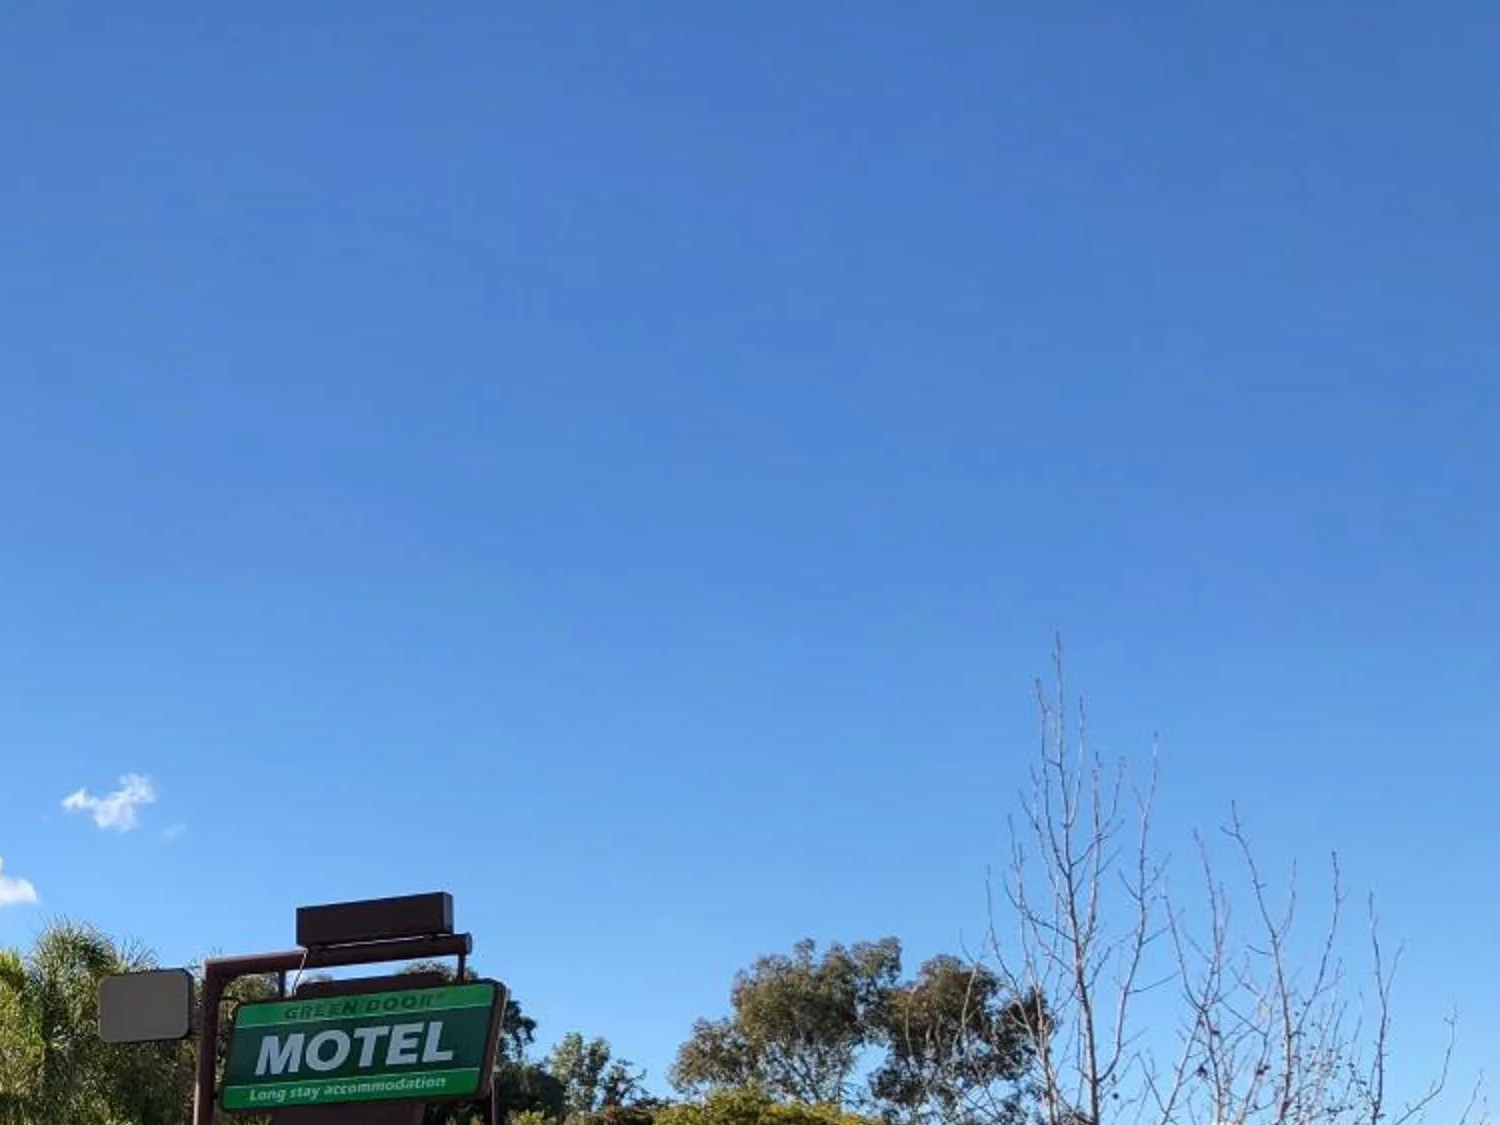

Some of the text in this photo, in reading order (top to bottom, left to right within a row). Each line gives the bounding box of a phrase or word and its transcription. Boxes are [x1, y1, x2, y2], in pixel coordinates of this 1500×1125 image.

[283, 999, 358, 1020] GREEN
[254, 1021, 453, 1076] MOTEL
[249, 1075, 447, 1103] Long stay accommodation
